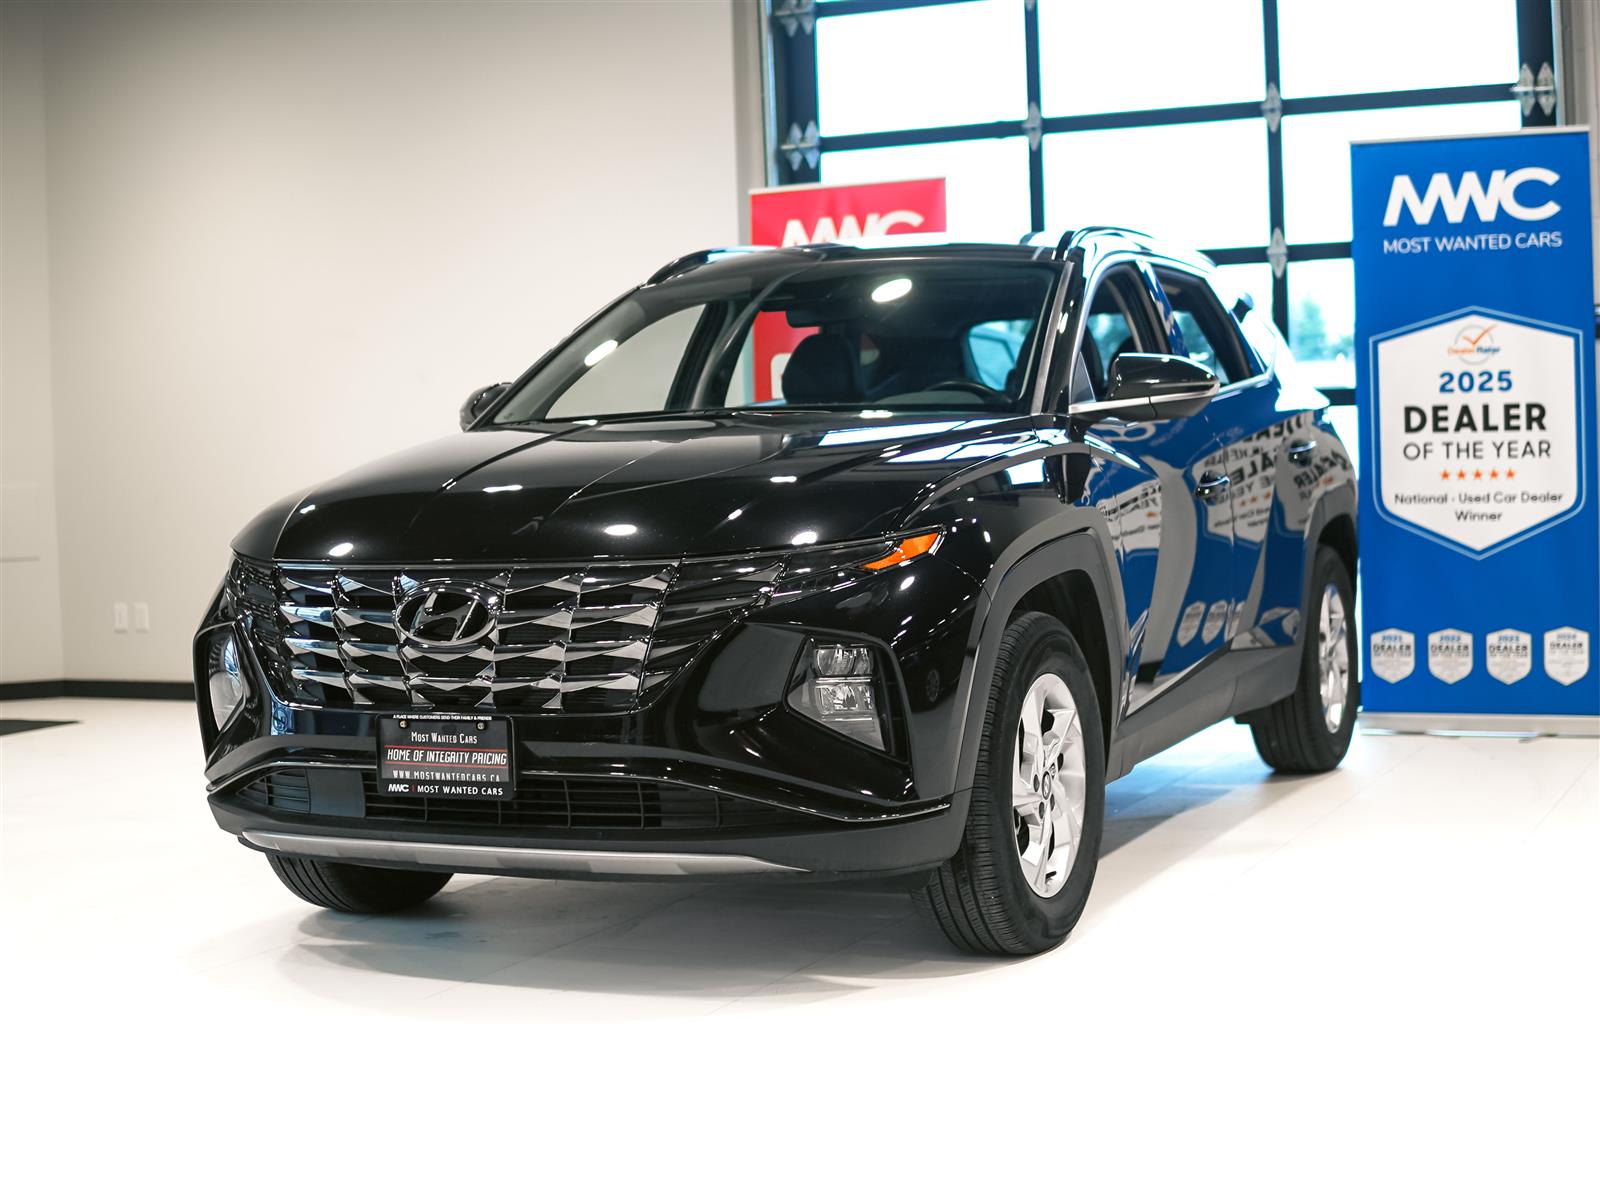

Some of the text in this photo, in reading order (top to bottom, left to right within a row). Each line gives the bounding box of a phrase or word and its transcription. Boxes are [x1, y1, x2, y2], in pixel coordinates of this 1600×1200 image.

[1383, 166, 1562, 227] MWC
[1383, 231, 1563, 254] MOST WANTED CARS
[1438, 369, 1513, 393] 2025
[1404, 402, 1547, 433] DEALER
[1403, 440, 1551, 461] OF THE YEAR
[1394, 492, 1448, 505] National
[1458, 493, 1490, 505] Used
[1493, 491, 1517, 504] Car
[1520, 490, 1563, 503] Dealer
[1455, 511, 1503, 522] Winner
[387, 749, 507, 765] HOME OF INTEGRITY PRICING
[417, 785, 440, 793] MOST
[443, 785, 479, 795] WANTED
[481, 787, 503, 796] CARS
